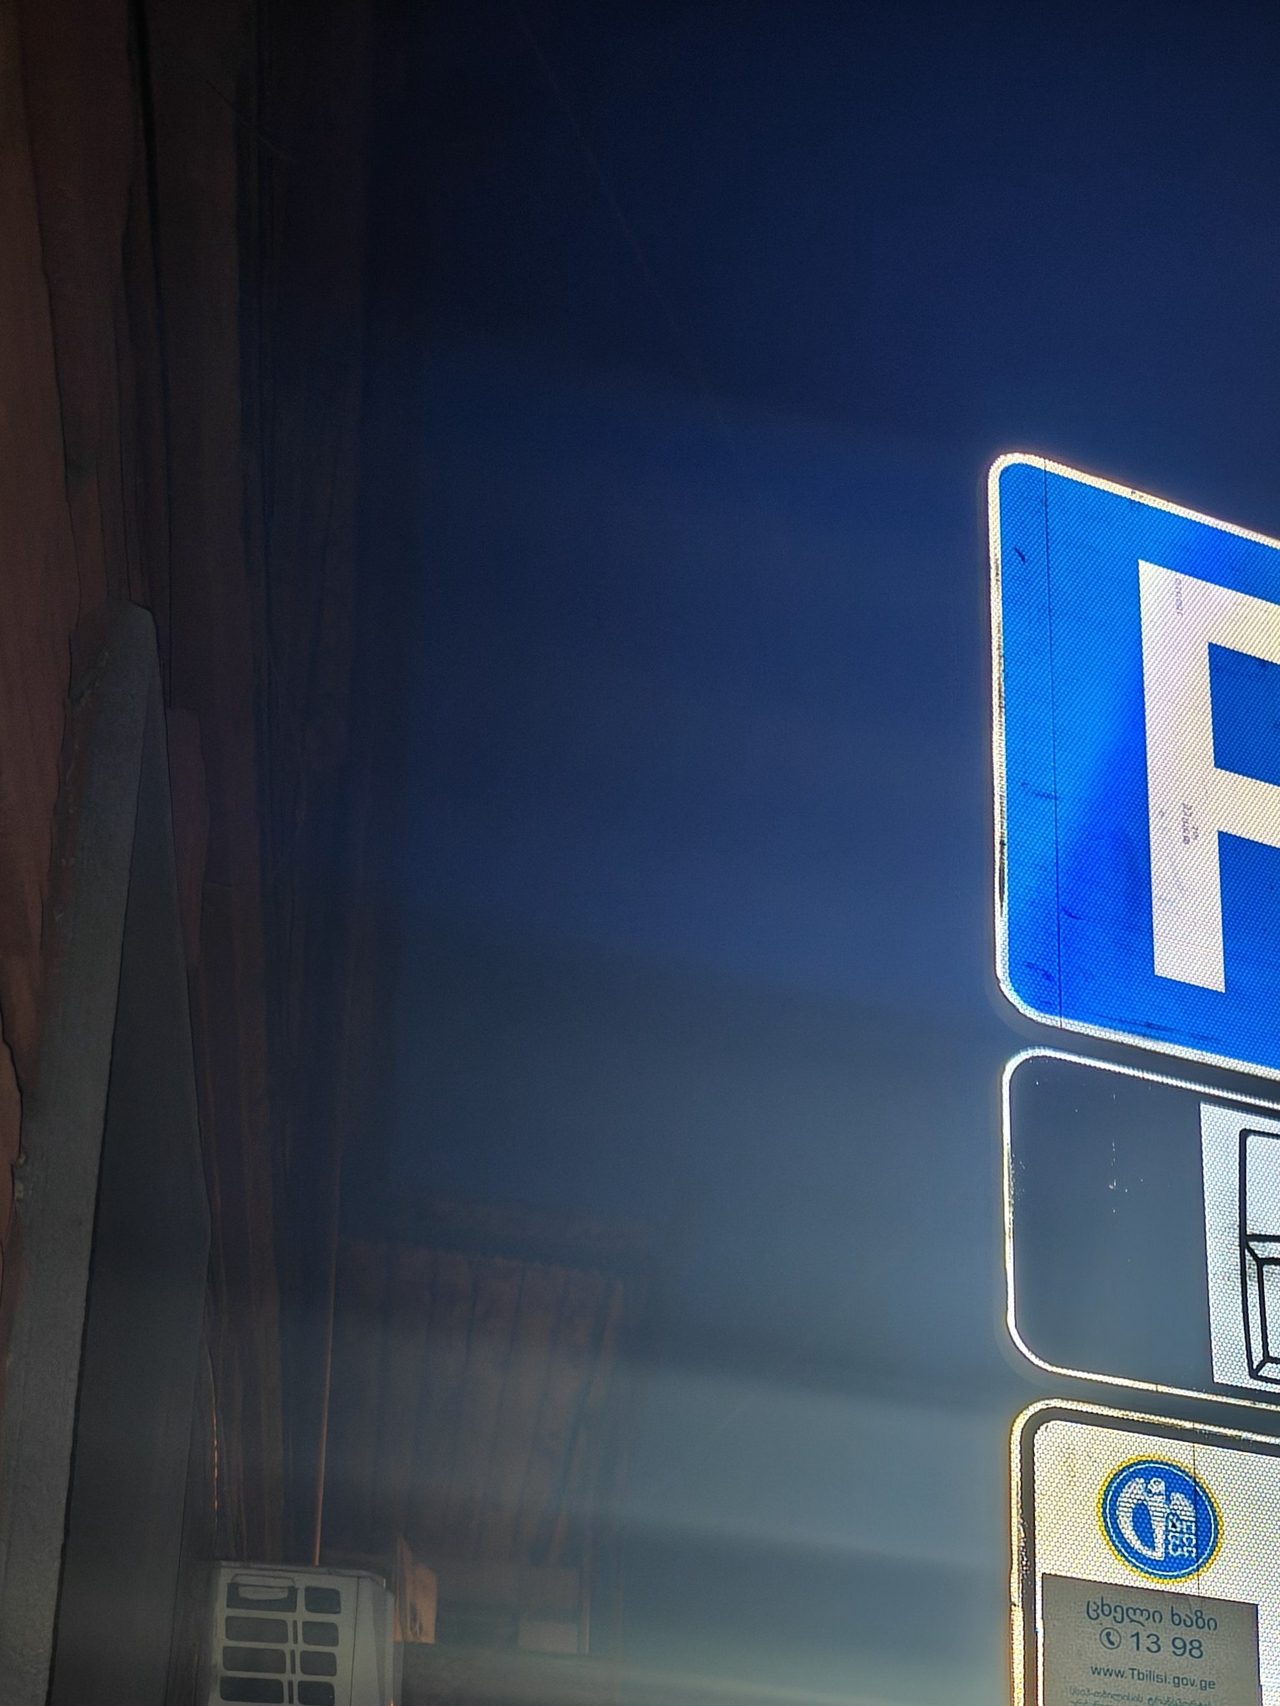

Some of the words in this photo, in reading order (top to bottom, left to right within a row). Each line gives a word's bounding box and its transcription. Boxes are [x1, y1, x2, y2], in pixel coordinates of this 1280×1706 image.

[1086, 1596, 1163, 1627] ცხელი
[1170, 1605, 1218, 1631] ხაზი
[1130, 1631, 1161, 1654] 13
[1171, 1636, 1204, 1659] 98
[1090, 1664, 1216, 1691] www.Tbilisi.gov.ge
